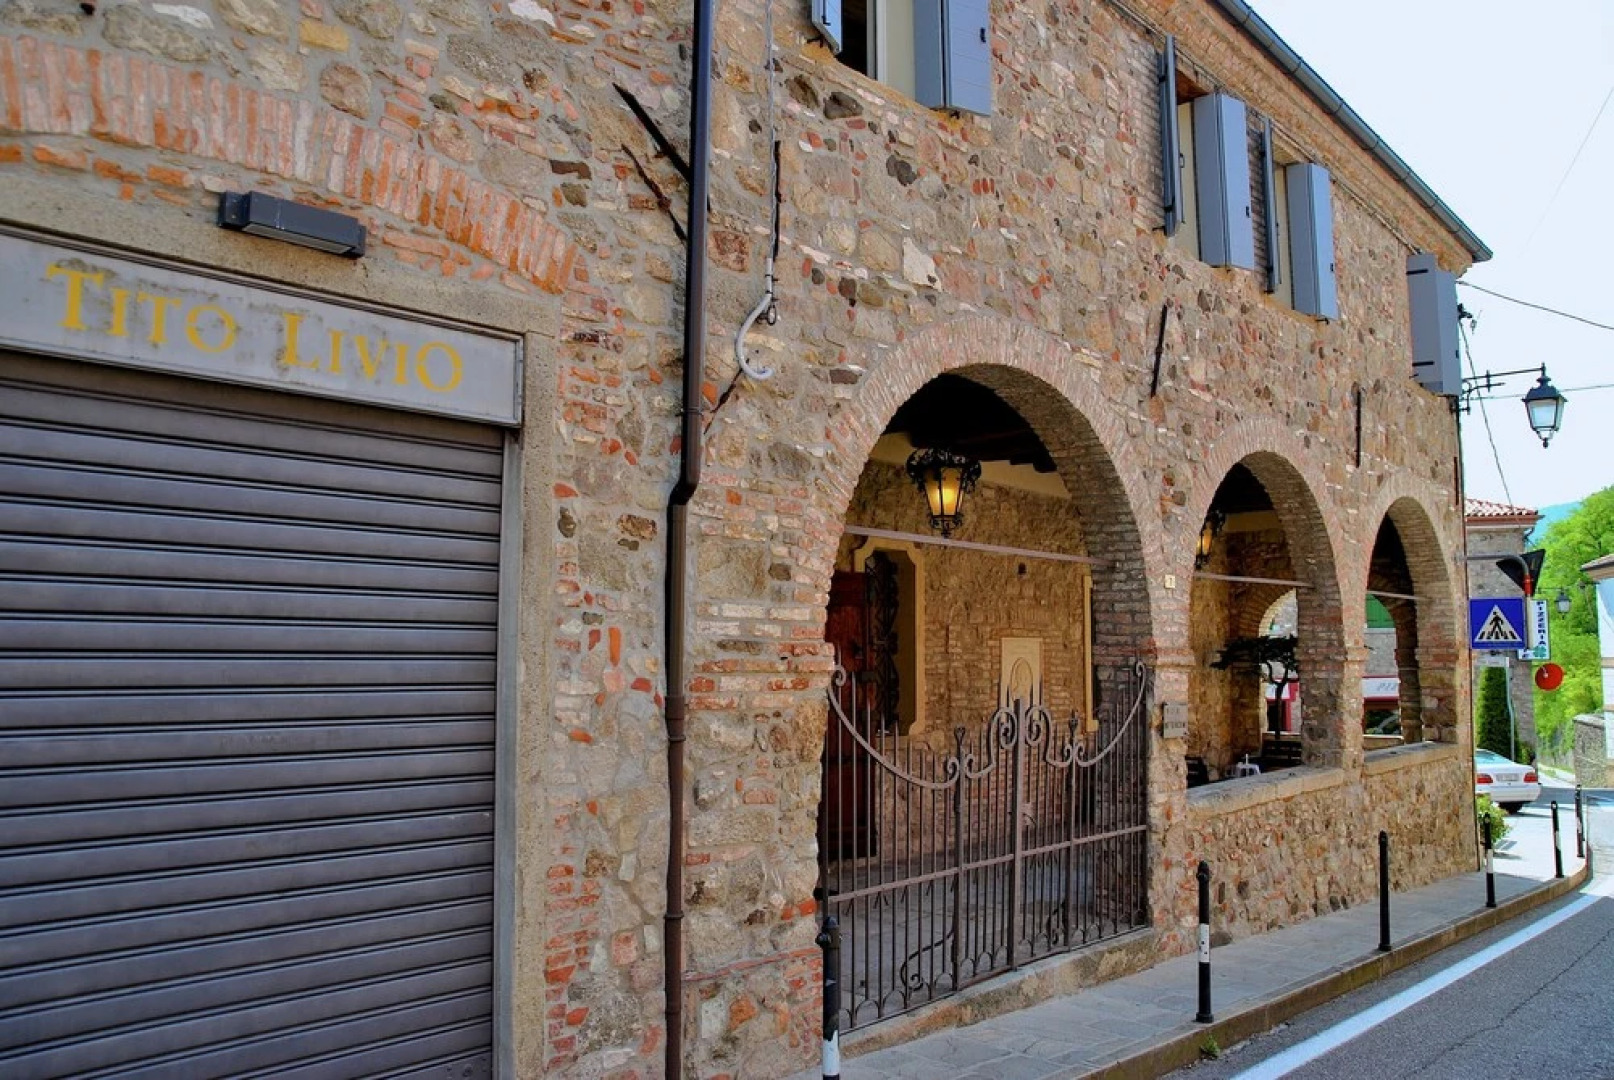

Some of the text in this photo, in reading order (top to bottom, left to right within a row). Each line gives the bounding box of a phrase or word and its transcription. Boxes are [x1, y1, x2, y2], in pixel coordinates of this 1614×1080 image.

[46, 263, 463, 392] TITO LIVIO
[1536, 601, 1546, 645] PIZZERIA
